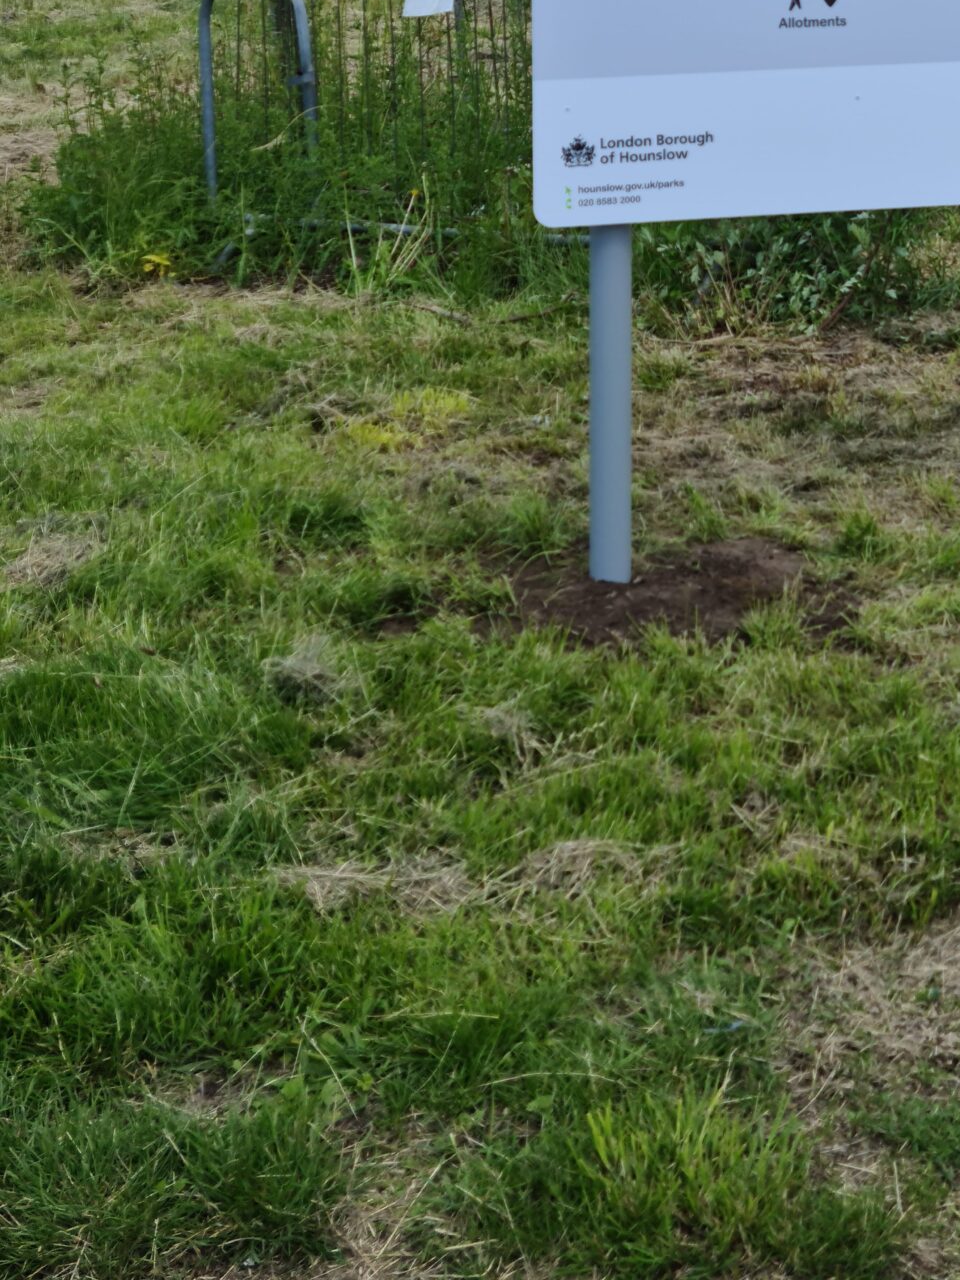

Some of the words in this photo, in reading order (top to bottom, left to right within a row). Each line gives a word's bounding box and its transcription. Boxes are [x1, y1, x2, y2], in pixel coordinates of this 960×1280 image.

[779, 16, 847, 29] Allotments
[600, 135, 651, 149] London
[656, 131, 714, 147] Borough
[600, 152, 615, 164] of
[620, 149, 688, 163] Hounslow
[578, 179, 684, 194] hounslow.gov.uk/parks
[578, 198, 594, 207] 020
[596, 197, 617, 206] 8583
[620, 195, 640, 204] 2000
